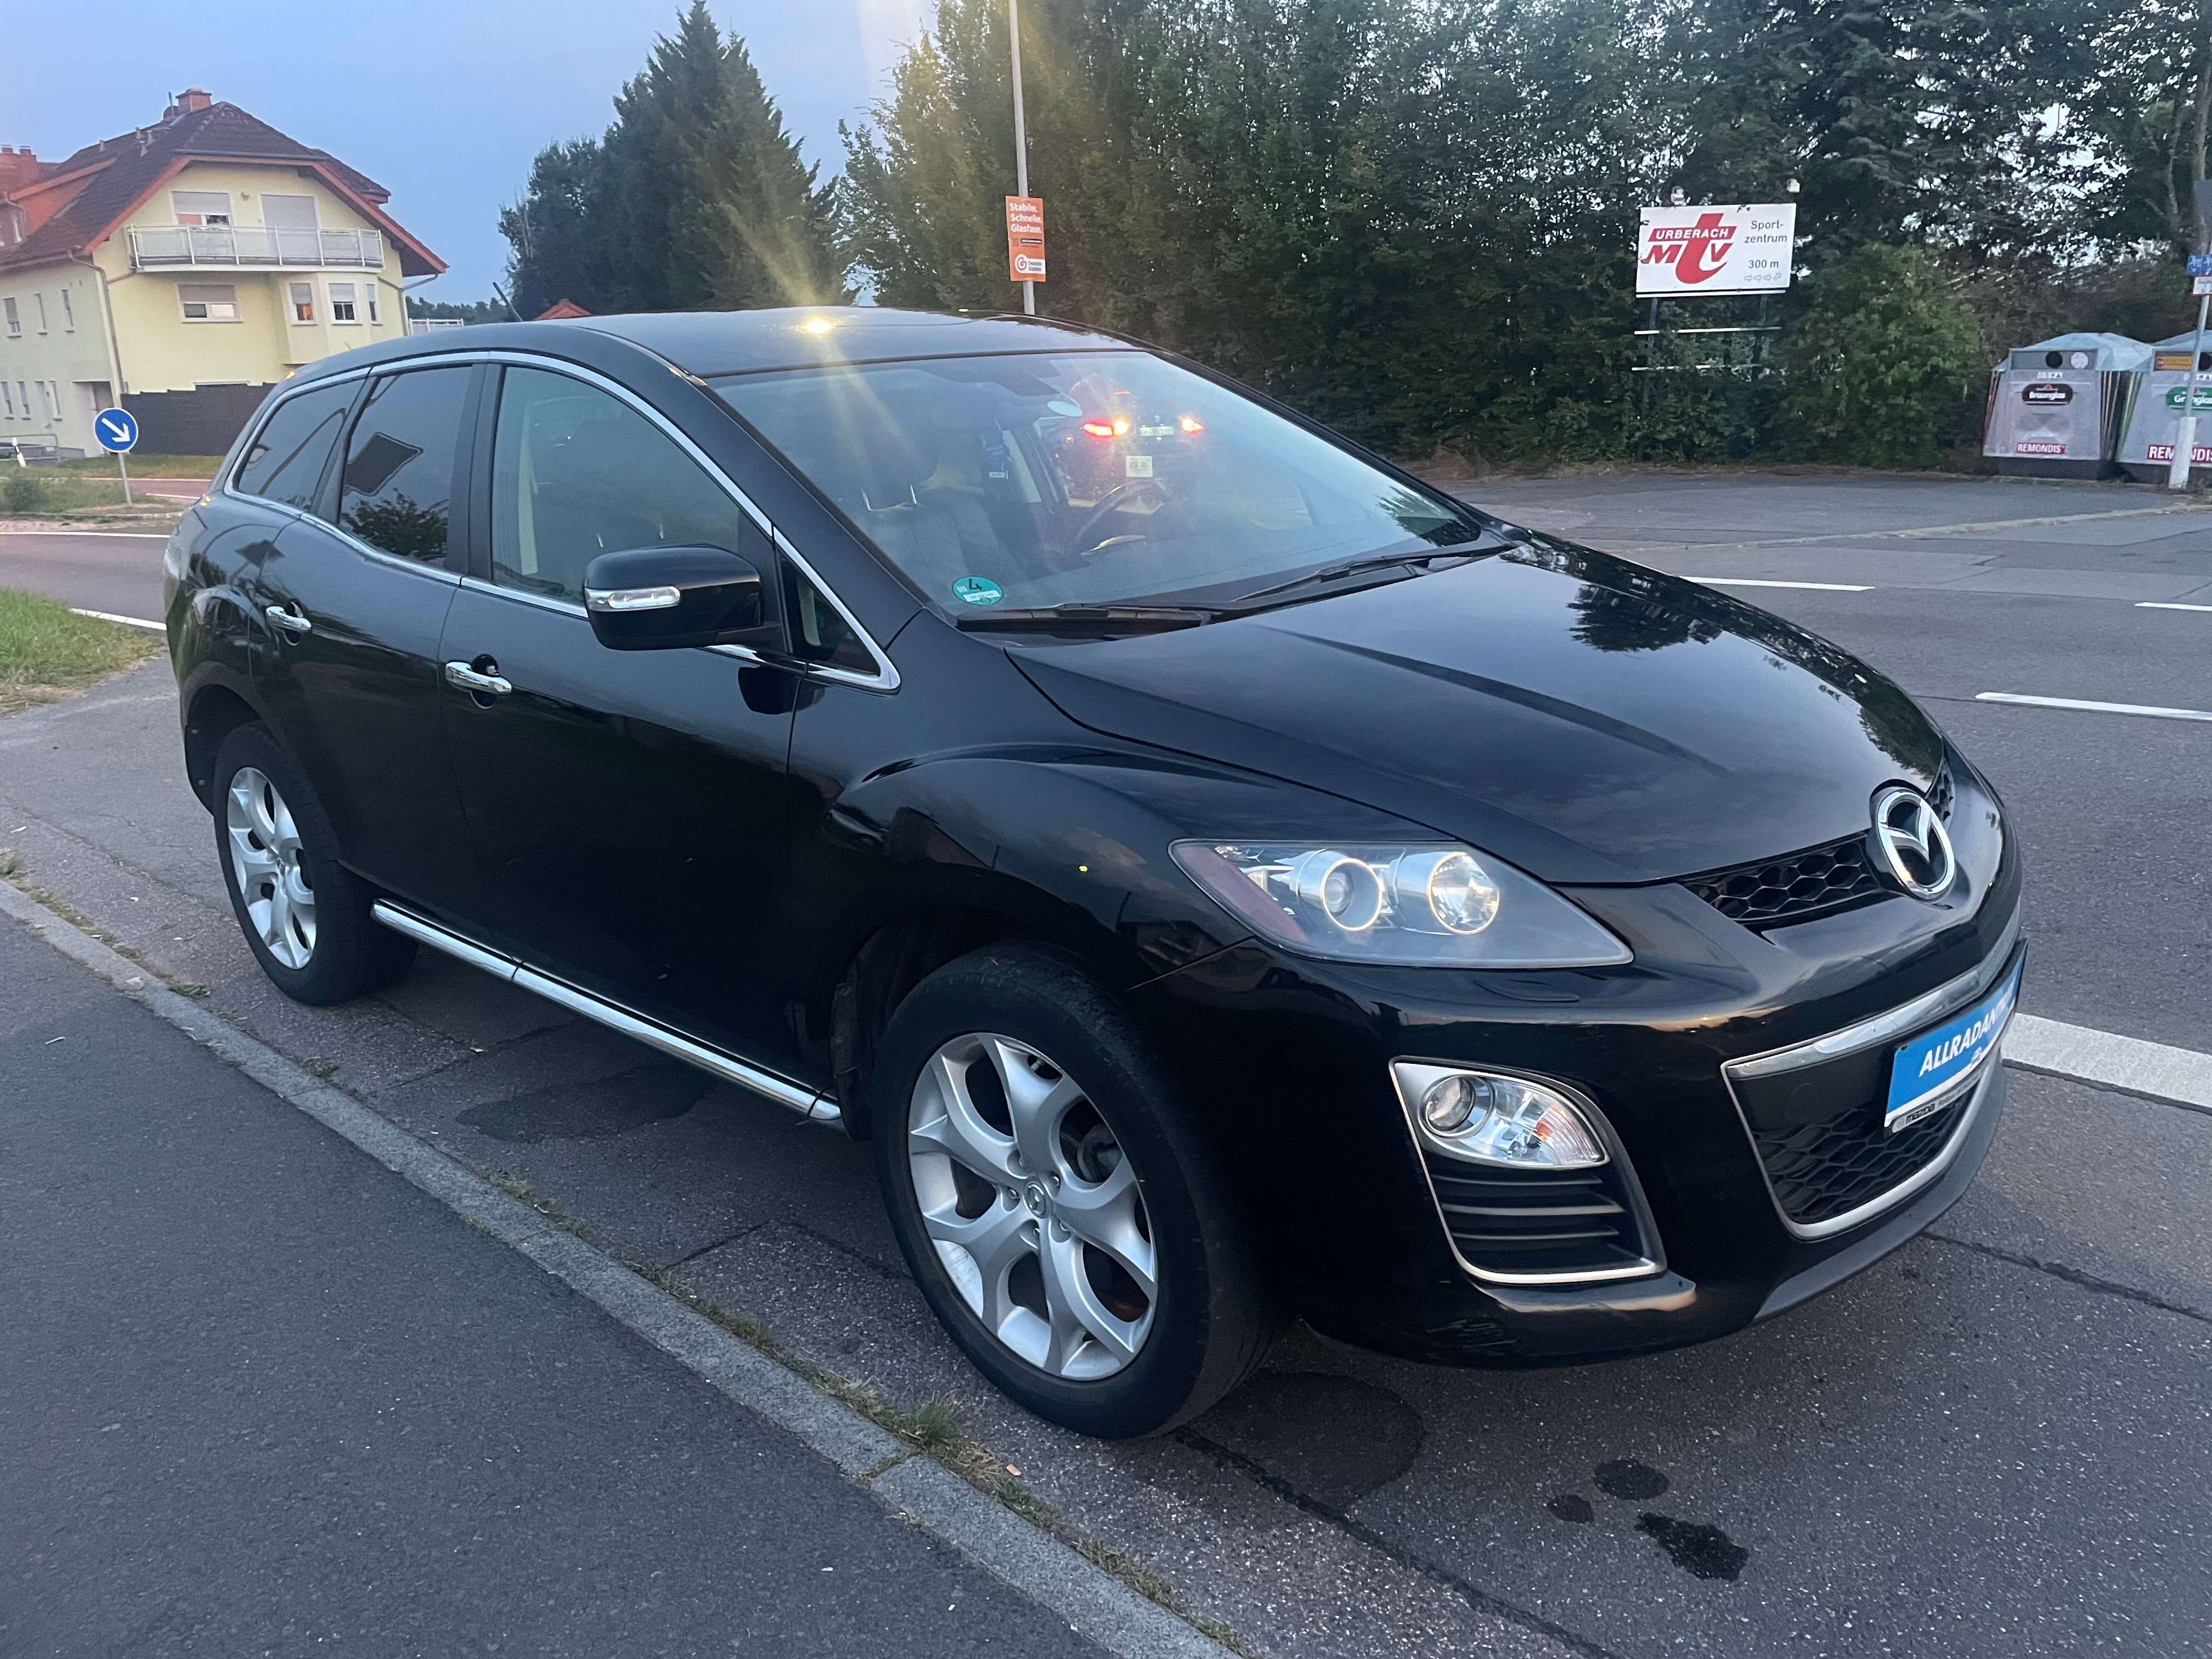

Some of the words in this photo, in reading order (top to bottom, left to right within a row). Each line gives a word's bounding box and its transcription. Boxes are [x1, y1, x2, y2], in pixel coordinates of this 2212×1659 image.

[1751, 220, 1784, 232] Sport-
[1656, 228, 1729, 240] URBERACH
[1744, 234, 1787, 244] zentrum
[1748, 259, 1767, 269] 300
[2017, 444, 2062, 454] REMONDIS
